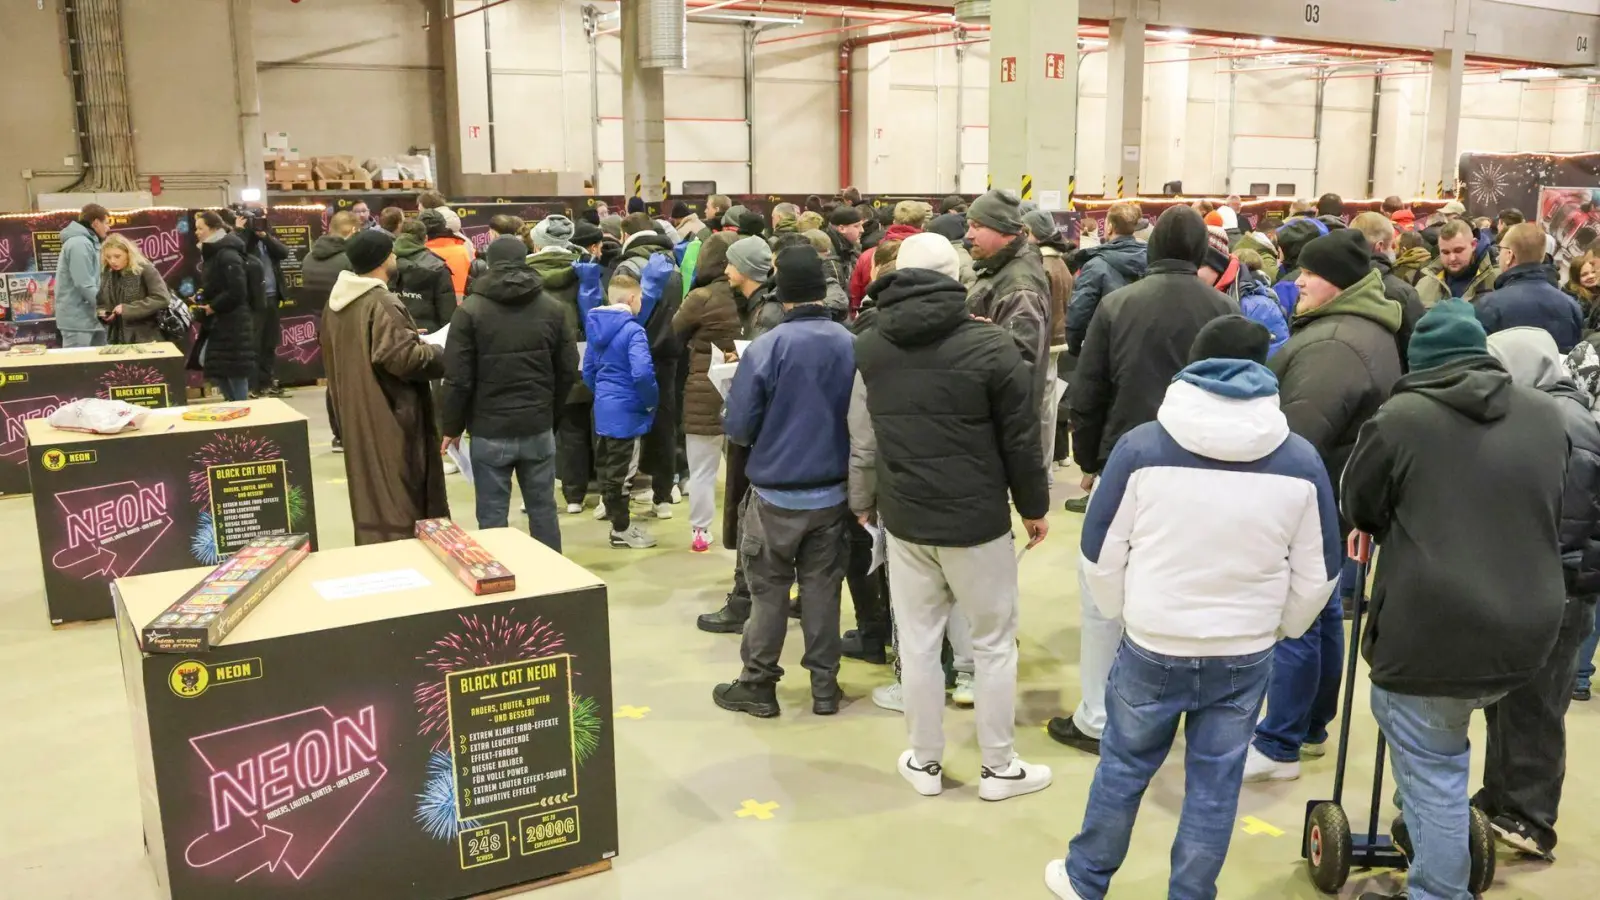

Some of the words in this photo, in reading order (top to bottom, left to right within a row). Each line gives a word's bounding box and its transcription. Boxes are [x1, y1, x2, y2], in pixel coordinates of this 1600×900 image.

[1306, 4, 1320, 23] 03
[1576, 36, 1588, 52] 04
[116, 388, 133, 397] BLACK
[135, 388, 145, 396] CAT
[146, 387, 161, 395] NEON
[70, 453, 90, 462] NEON
[216, 468, 240, 479] BLACK
[242, 466, 255, 476] CAT
[258, 464, 276, 474] NEON
[67, 482, 167, 549] NEON
[216, 663, 251, 680] NEON
[460, 674, 498, 693] BLACK
[502, 668, 522, 686] CAT
[527, 663, 556, 681] NEON
[471, 704, 498, 716] ANDERS,
[500, 700, 524, 712] LAUTER,
[526, 695, 550, 708] BUNTER
[494, 713, 507, 723] UND
[509, 709, 535, 721] BESSER!
[470, 730, 493, 742] EXTREM
[495, 726, 514, 737] KLARE
[516, 718, 559, 734] FARB-EFFEKTE
[470, 741, 490, 752] EXTRA
[491, 734, 529, 749] LEUCHTENDE
[471, 747, 518, 762] EFFEKT-FARBEN
[210, 704, 377, 832] NEON
[472, 762, 496, 774] RIESIGE
[498, 757, 523, 769] KALIBER
[473, 774, 485, 784] FÜR
[486, 770, 505, 782] VOLLE
[507, 766, 528, 778] POWER
[473, 783, 497, 794] EXTREM
[499, 778, 521, 790] LAUTER
[523, 769, 566, 785] EFFEKT-SOUND
[266, 805, 290, 820] ANDERS,
[290, 795, 312, 810] LAUTER,
[311, 785, 333, 799] BUNTER
[336, 778, 348, 788] UND
[348, 768, 370, 783] BESSER!
[474, 791, 511, 805] INNOVATIVE
[512, 785, 536, 797] EFFEKTE
[526, 818, 574, 843] 2000G
[468, 834, 500, 856] 24S
[476, 854, 494, 862] SCHUSS
